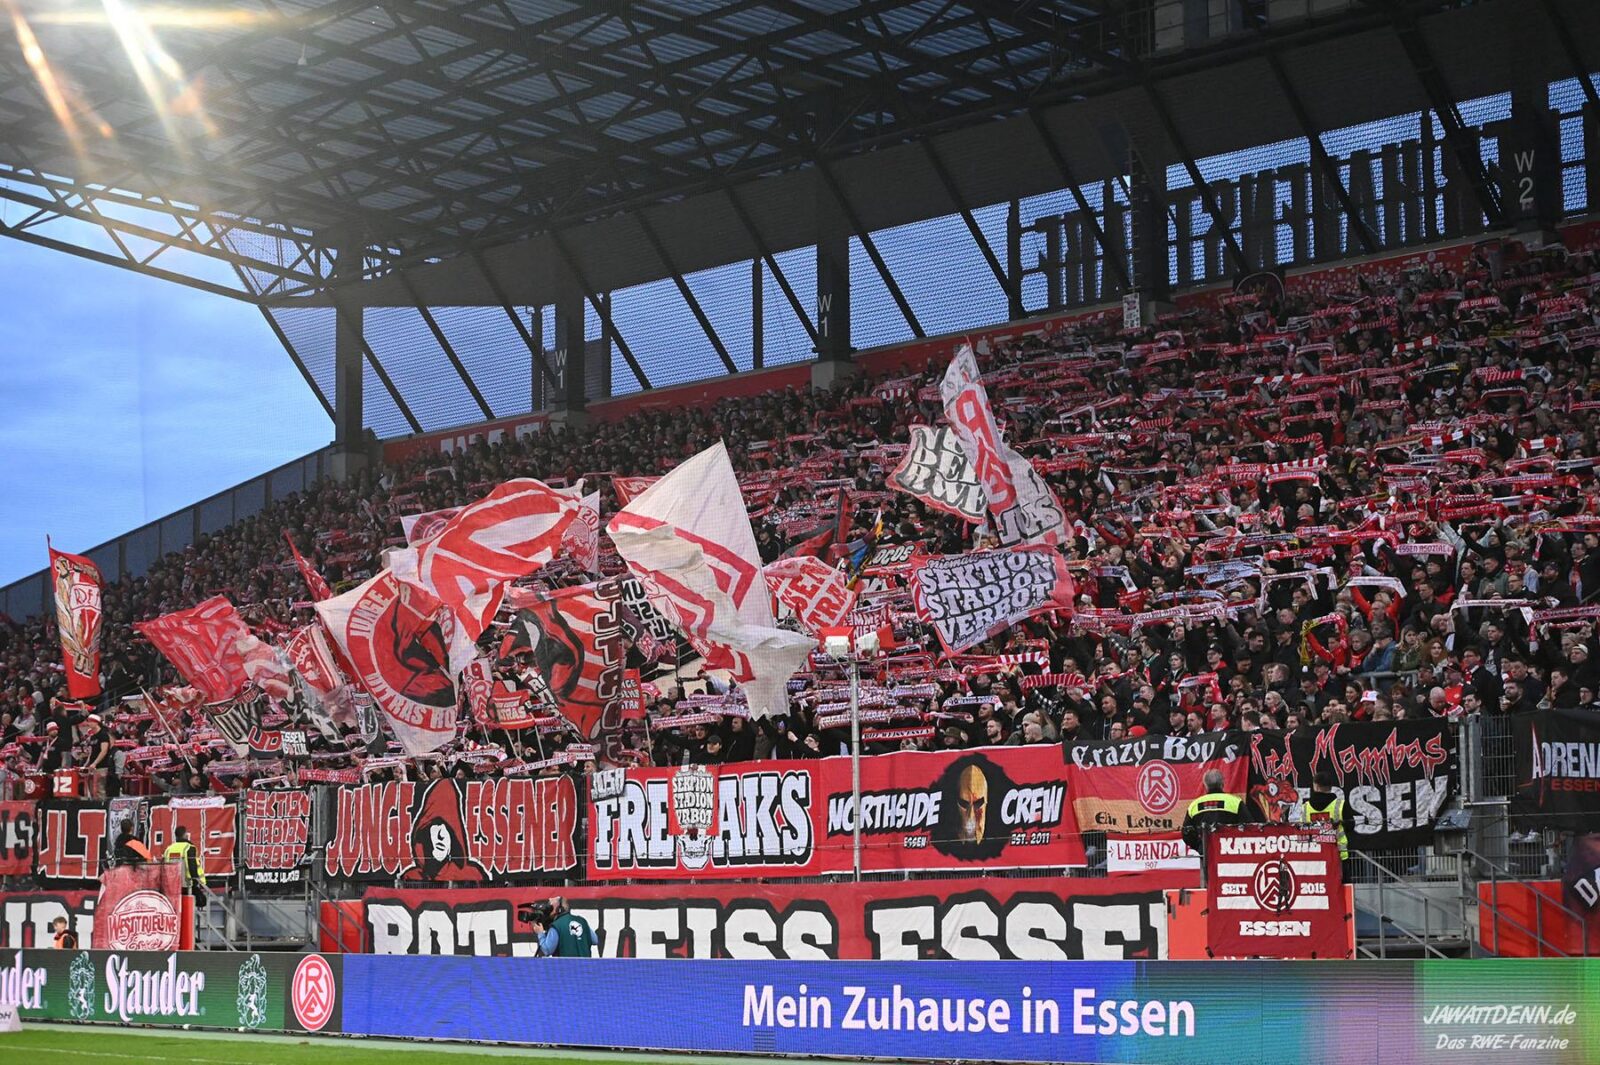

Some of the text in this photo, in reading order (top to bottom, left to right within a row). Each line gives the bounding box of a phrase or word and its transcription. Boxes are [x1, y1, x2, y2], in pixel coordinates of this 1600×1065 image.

[1514, 150, 1535, 173] W
[818, 294, 832, 313] W
[555, 349, 567, 367] W
[870, 545, 915, 566] OCOS
[917, 551, 1050, 595] SEKTION
[926, 563, 1056, 620] STADION
[935, 582, 1051, 645] VERBOT
[1310, 722, 1448, 787] Mambas
[1532, 730, 1600, 779] ADREN
[672, 776, 714, 793] SEKTION
[246, 789, 311, 818] SEKTION
[673, 792, 714, 809] STADION
[827, 790, 943, 833] NORTHSIDE
[1000, 785, 1064, 826] CREW
[245, 817, 310, 844] STADION
[325, 774, 578, 877] JUNGE ESSENER
[1127, 814, 1173, 829] Leben
[904, 836, 927, 848] ESSEN
[1011, 833, 1029, 846] EST.
[1117, 841, 1180, 860] LA BANDA
[245, 844, 307, 869] VERBOT
[1221, 883, 1248, 895] SEIT
[1300, 882, 1326, 894] 2015
[1239, 920, 1311, 937] ESSEN
[104, 951, 206, 1023] Stauder
[743, 984, 1195, 1037] Mein Zuhause in Essen
